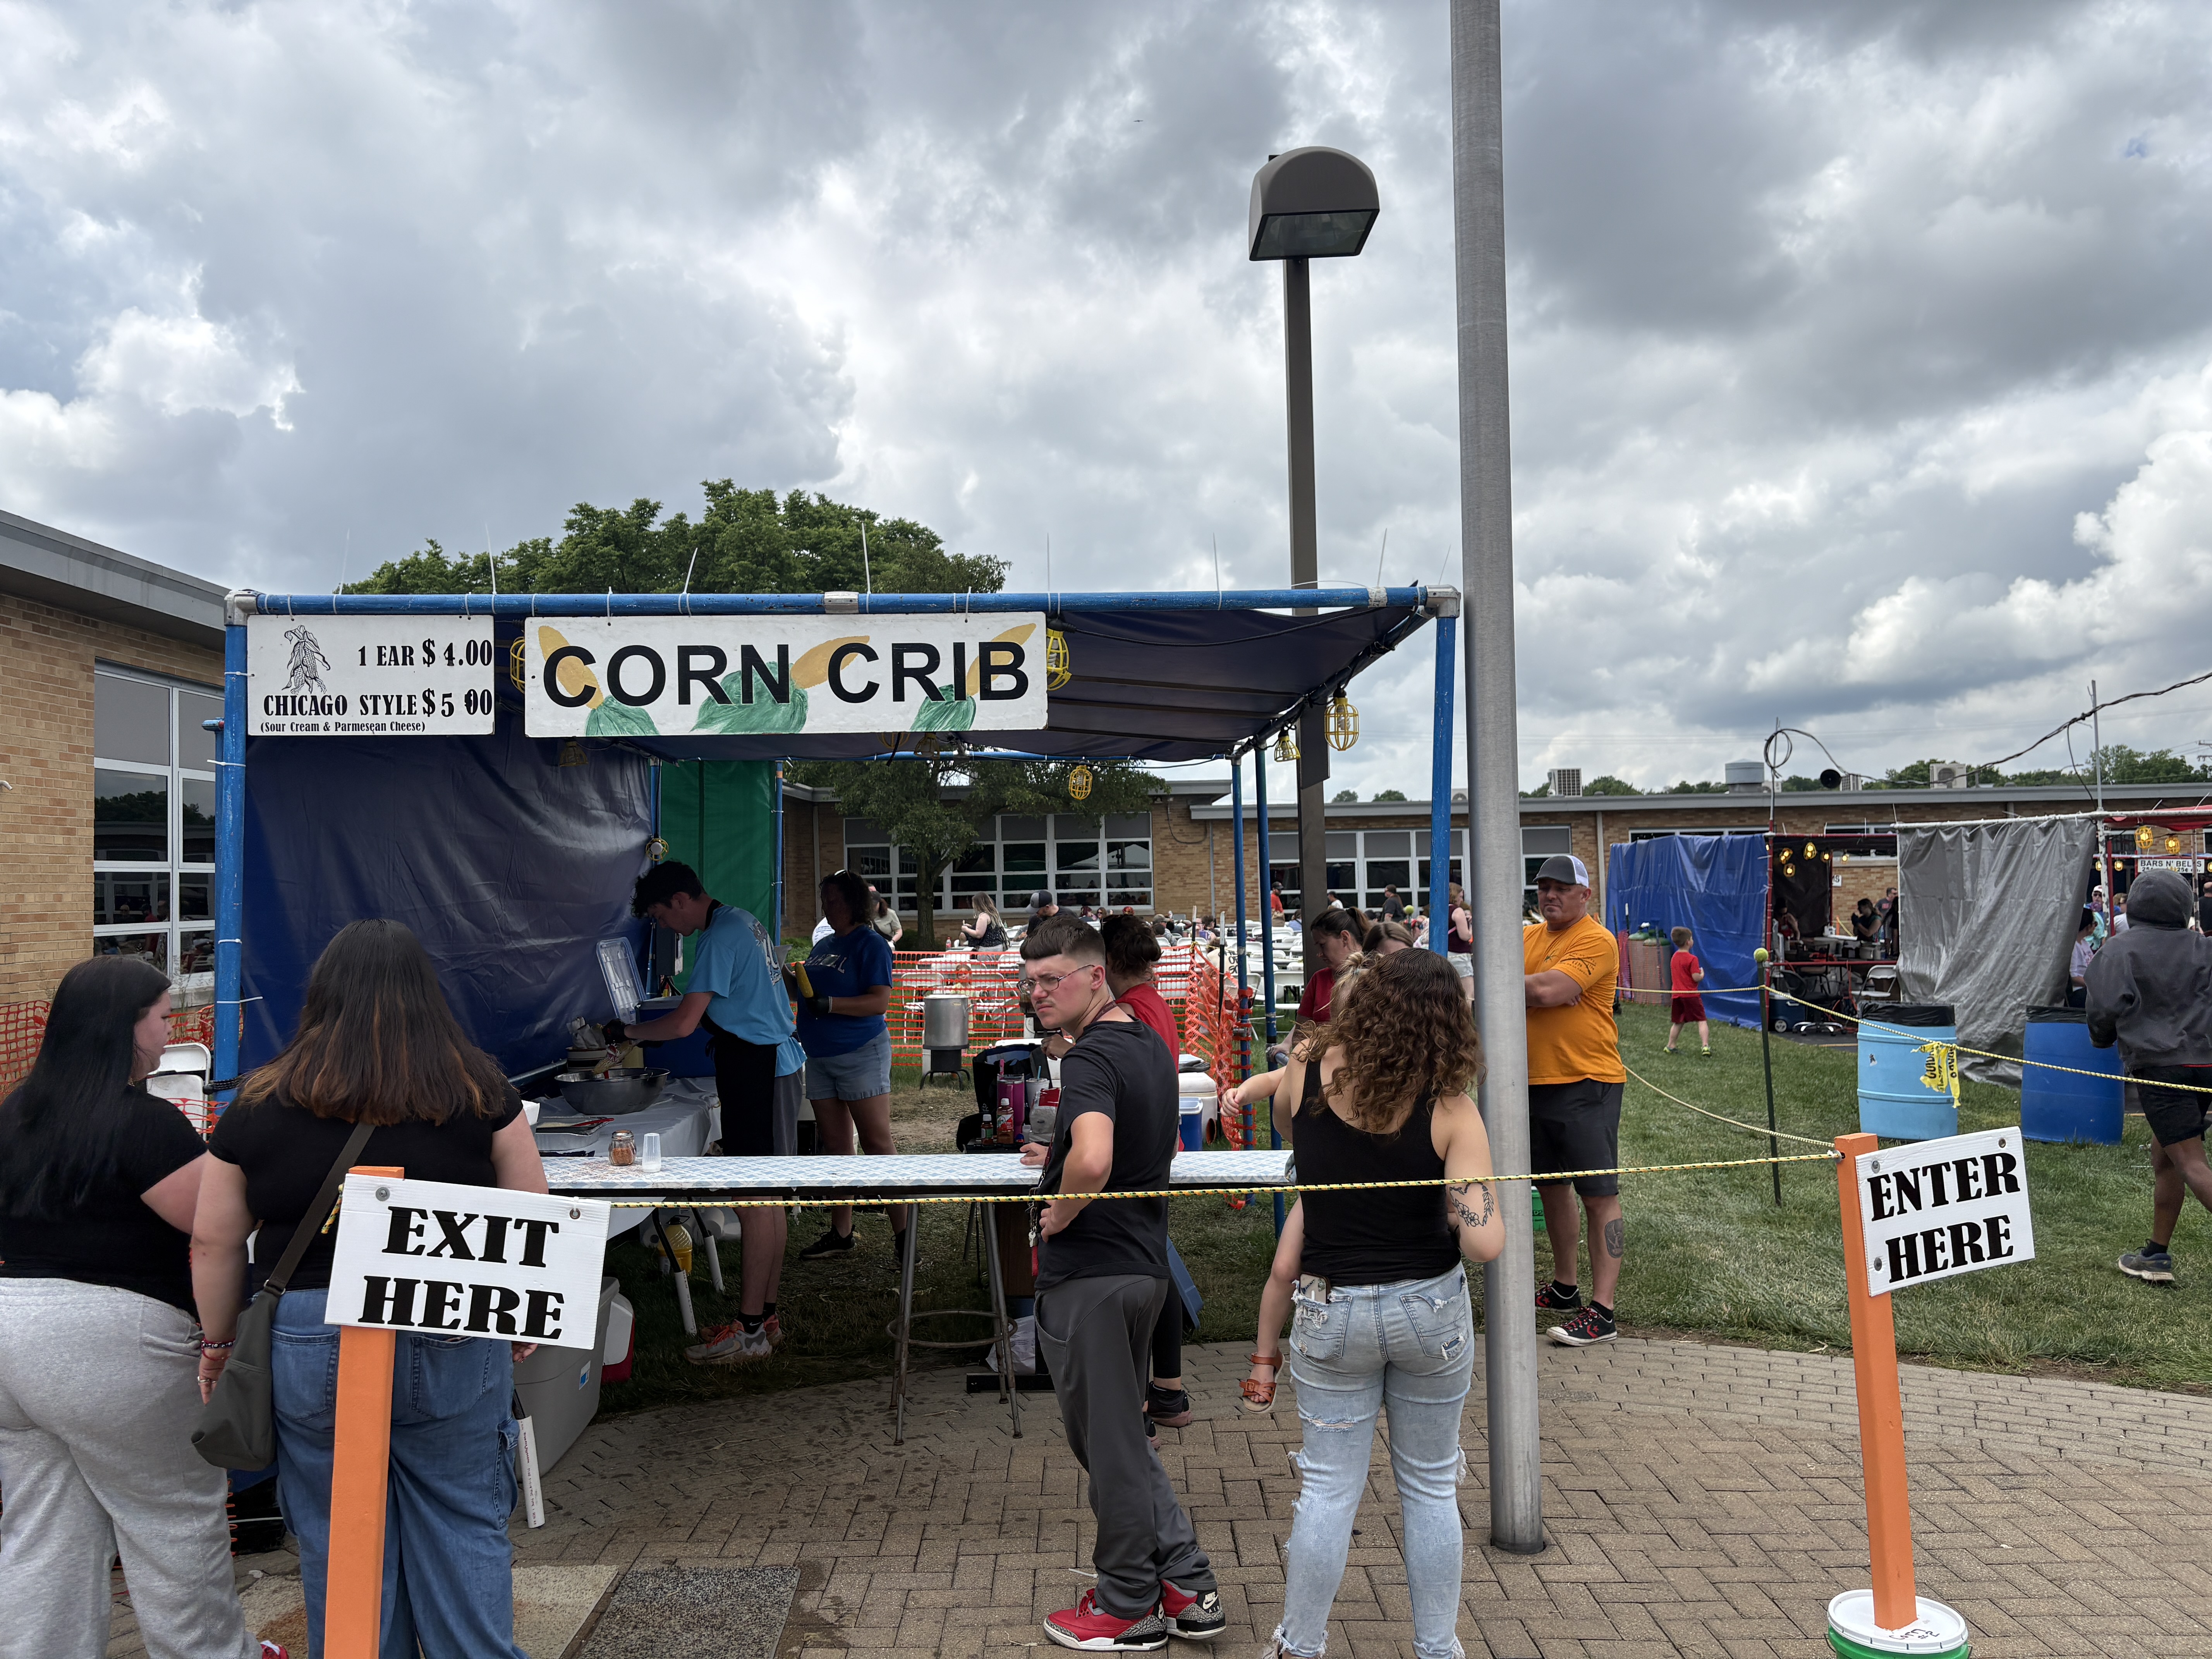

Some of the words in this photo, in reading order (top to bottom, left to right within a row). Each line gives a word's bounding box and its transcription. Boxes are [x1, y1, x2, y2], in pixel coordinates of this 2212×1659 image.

[359, 646, 366, 666] 1
[377, 646, 414, 666] EAR
[543, 644, 790, 708] CORN
[828, 641, 1029, 704] CRIB
[264, 695, 347, 716] CHICAGO
[360, 694, 417, 716] STYLE
[261, 722, 286, 733] (Sour
[290, 722, 319, 732] Cream
[323, 721, 330, 732] &
[335, 722, 386, 732] Parmesean
[390, 721, 425, 732] Cheese)
[1867, 1152, 2020, 1221] ENTER
[382, 1206, 560, 1268] EXIT
[1885, 1214, 2014, 1283] HERE
[358, 1276, 565, 1340] HERE
[1205, 1591, 1216, 1603] NIKE
[1889, 1629, 1926, 1640] Corn
[1918, 1631, 1940, 1639] #2
